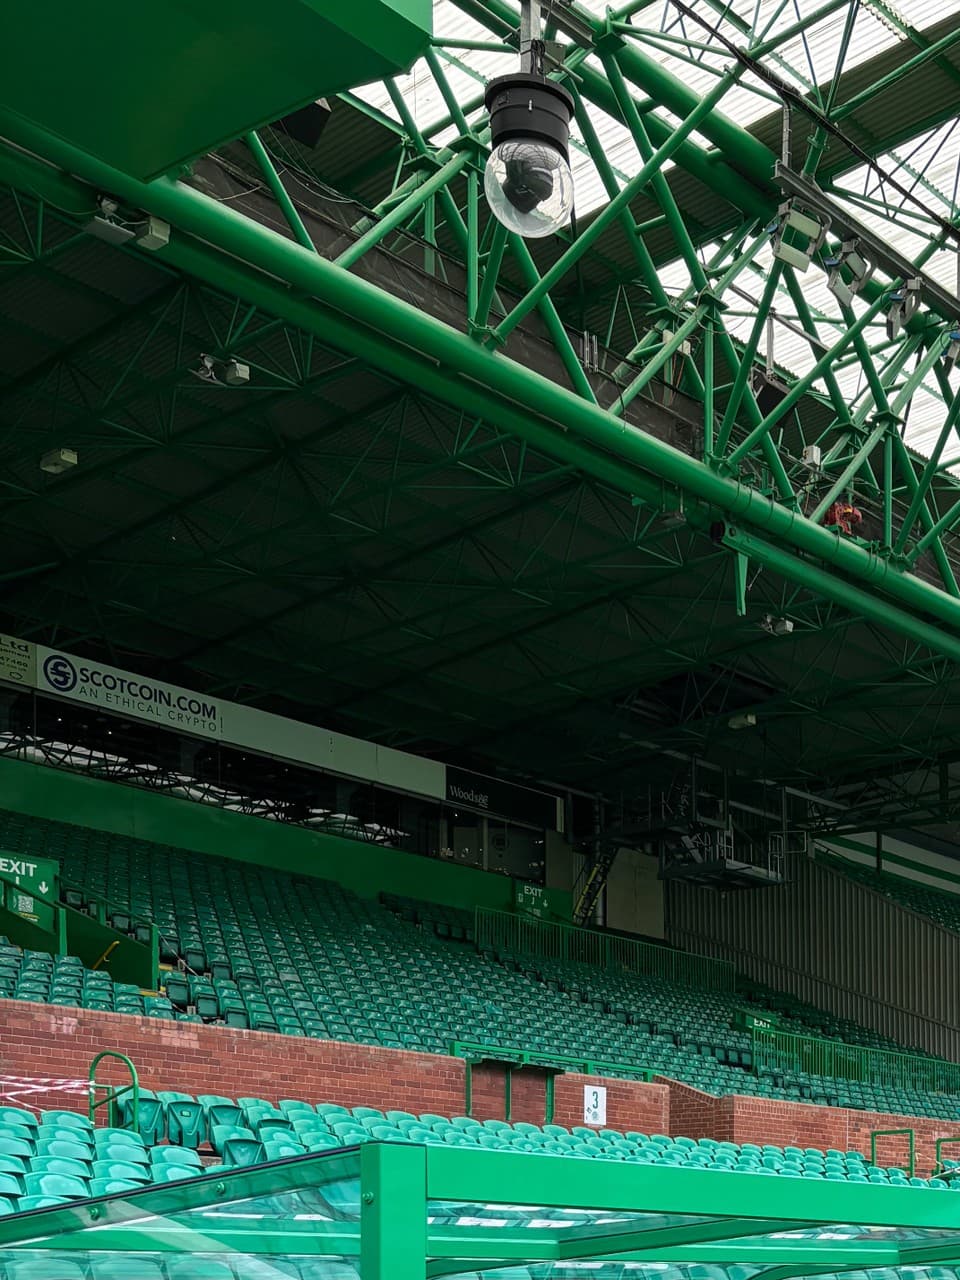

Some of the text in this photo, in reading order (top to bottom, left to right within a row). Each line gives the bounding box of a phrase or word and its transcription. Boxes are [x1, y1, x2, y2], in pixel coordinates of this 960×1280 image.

[79, 667, 217, 721] SCOTCOIN.COM
[79, 686, 218, 732] AN ETHICAL CRYPTO
[0, 857, 38, 878] EXIT
[523, 885, 543, 898] EXIT
[592, 1090, 599, 1110] 3
